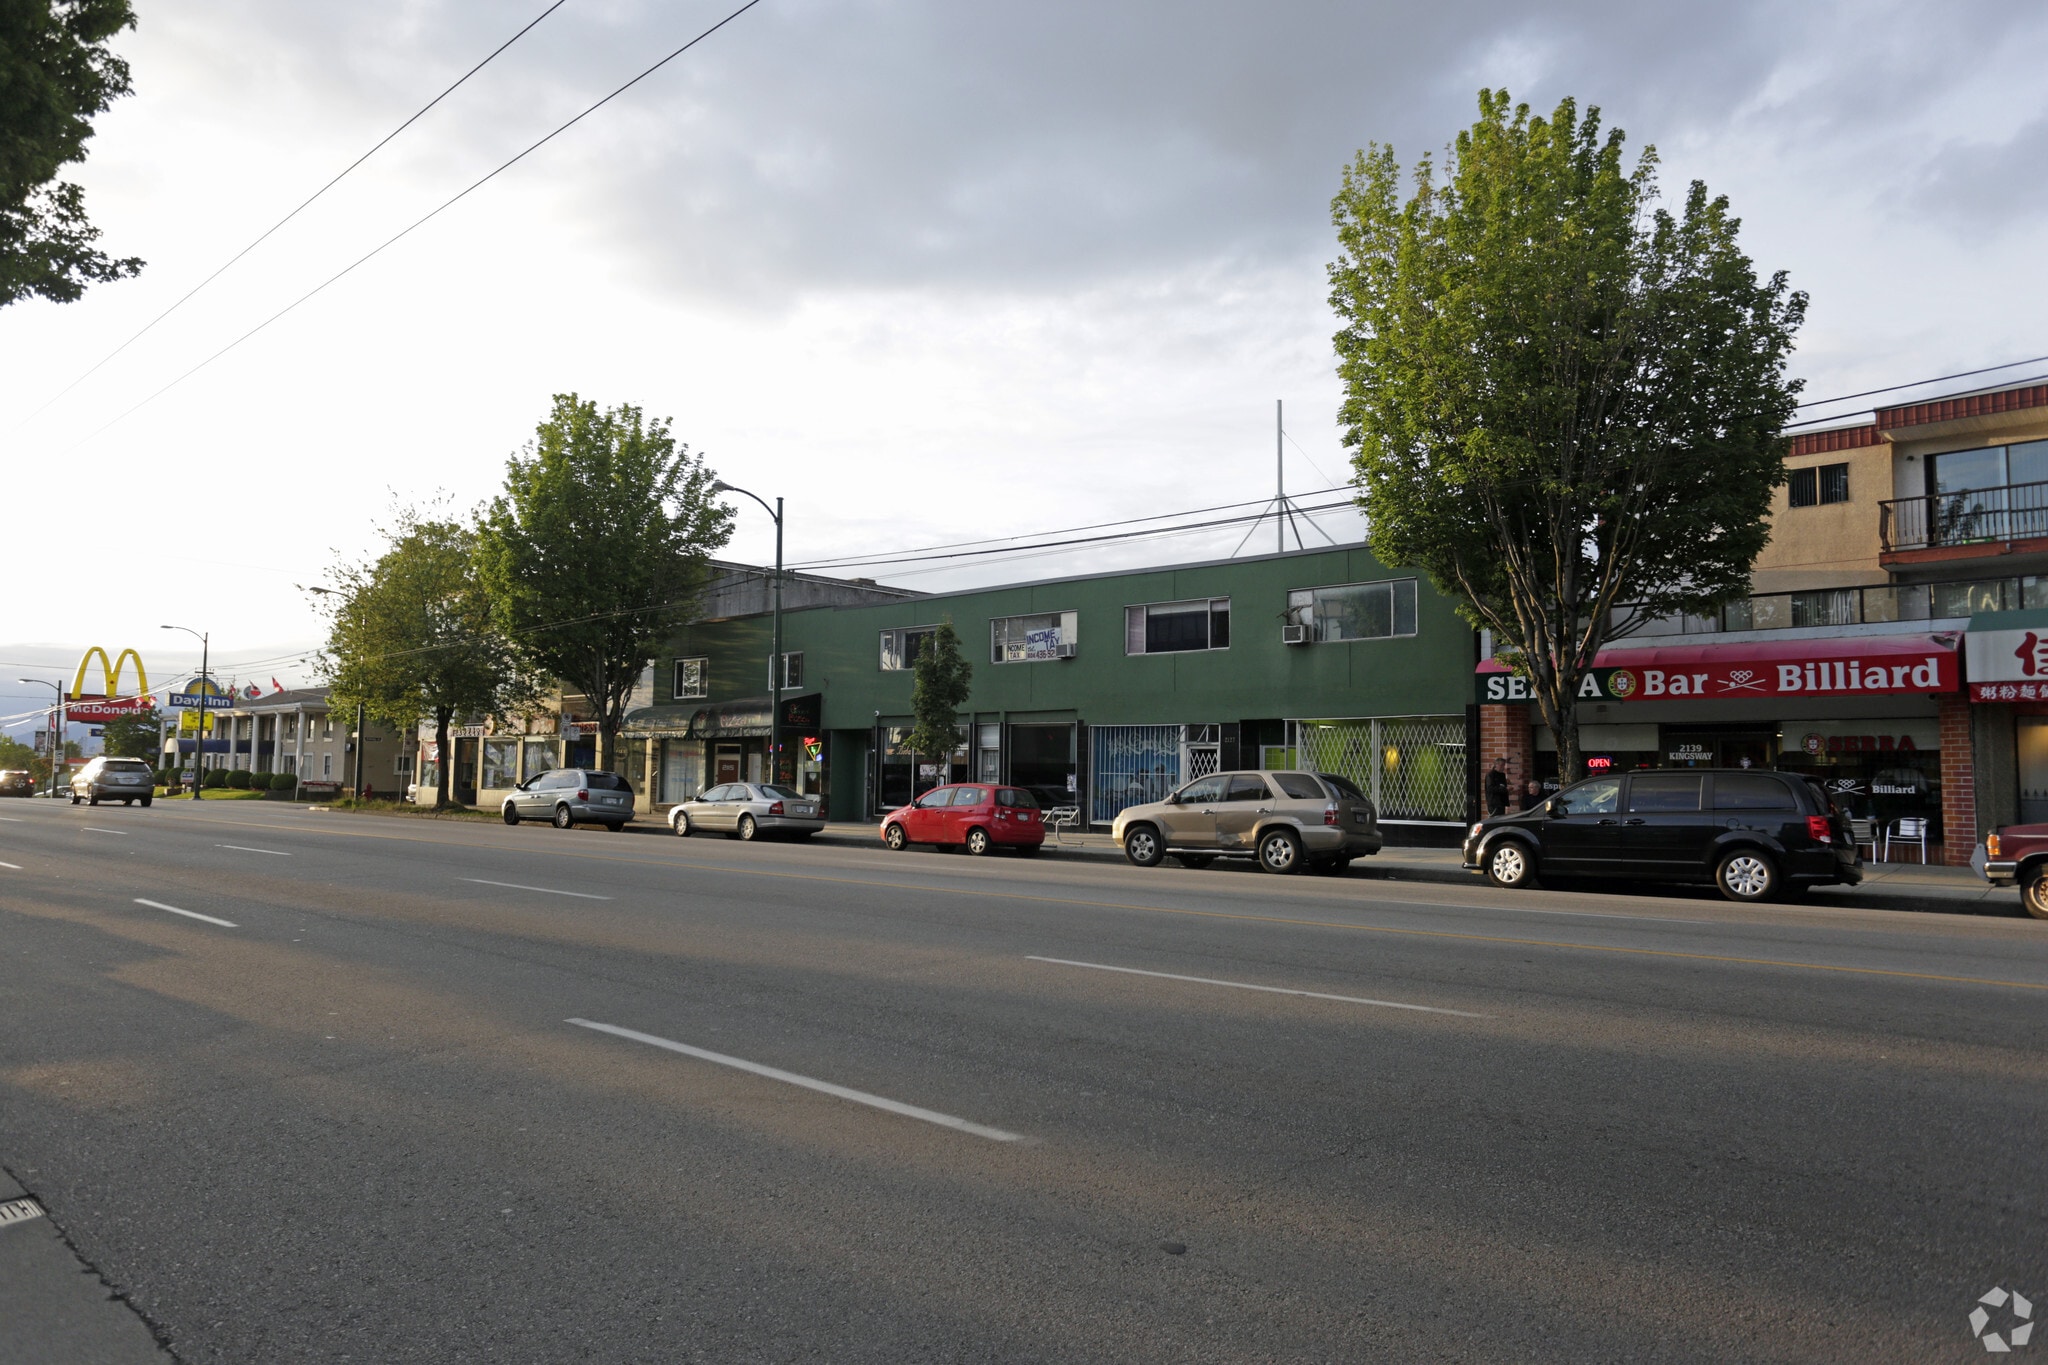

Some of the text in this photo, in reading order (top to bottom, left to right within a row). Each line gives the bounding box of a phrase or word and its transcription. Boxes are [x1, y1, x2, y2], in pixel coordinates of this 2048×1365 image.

[1026, 629, 1056, 645] INCOME
[1008, 644, 1025, 652] NCOME
[1487, 657, 1942, 700] SEA Bar Billiard
[208, 696, 231, 707] Inn
[1679, 744, 1703, 752] 2139
[1828, 735, 1917, 752] SERRA
[1668, 752, 1713, 760] KINGSWAY
[1587, 758, 1611, 768] OPEN
[1872, 784, 1916, 794] Billiard
